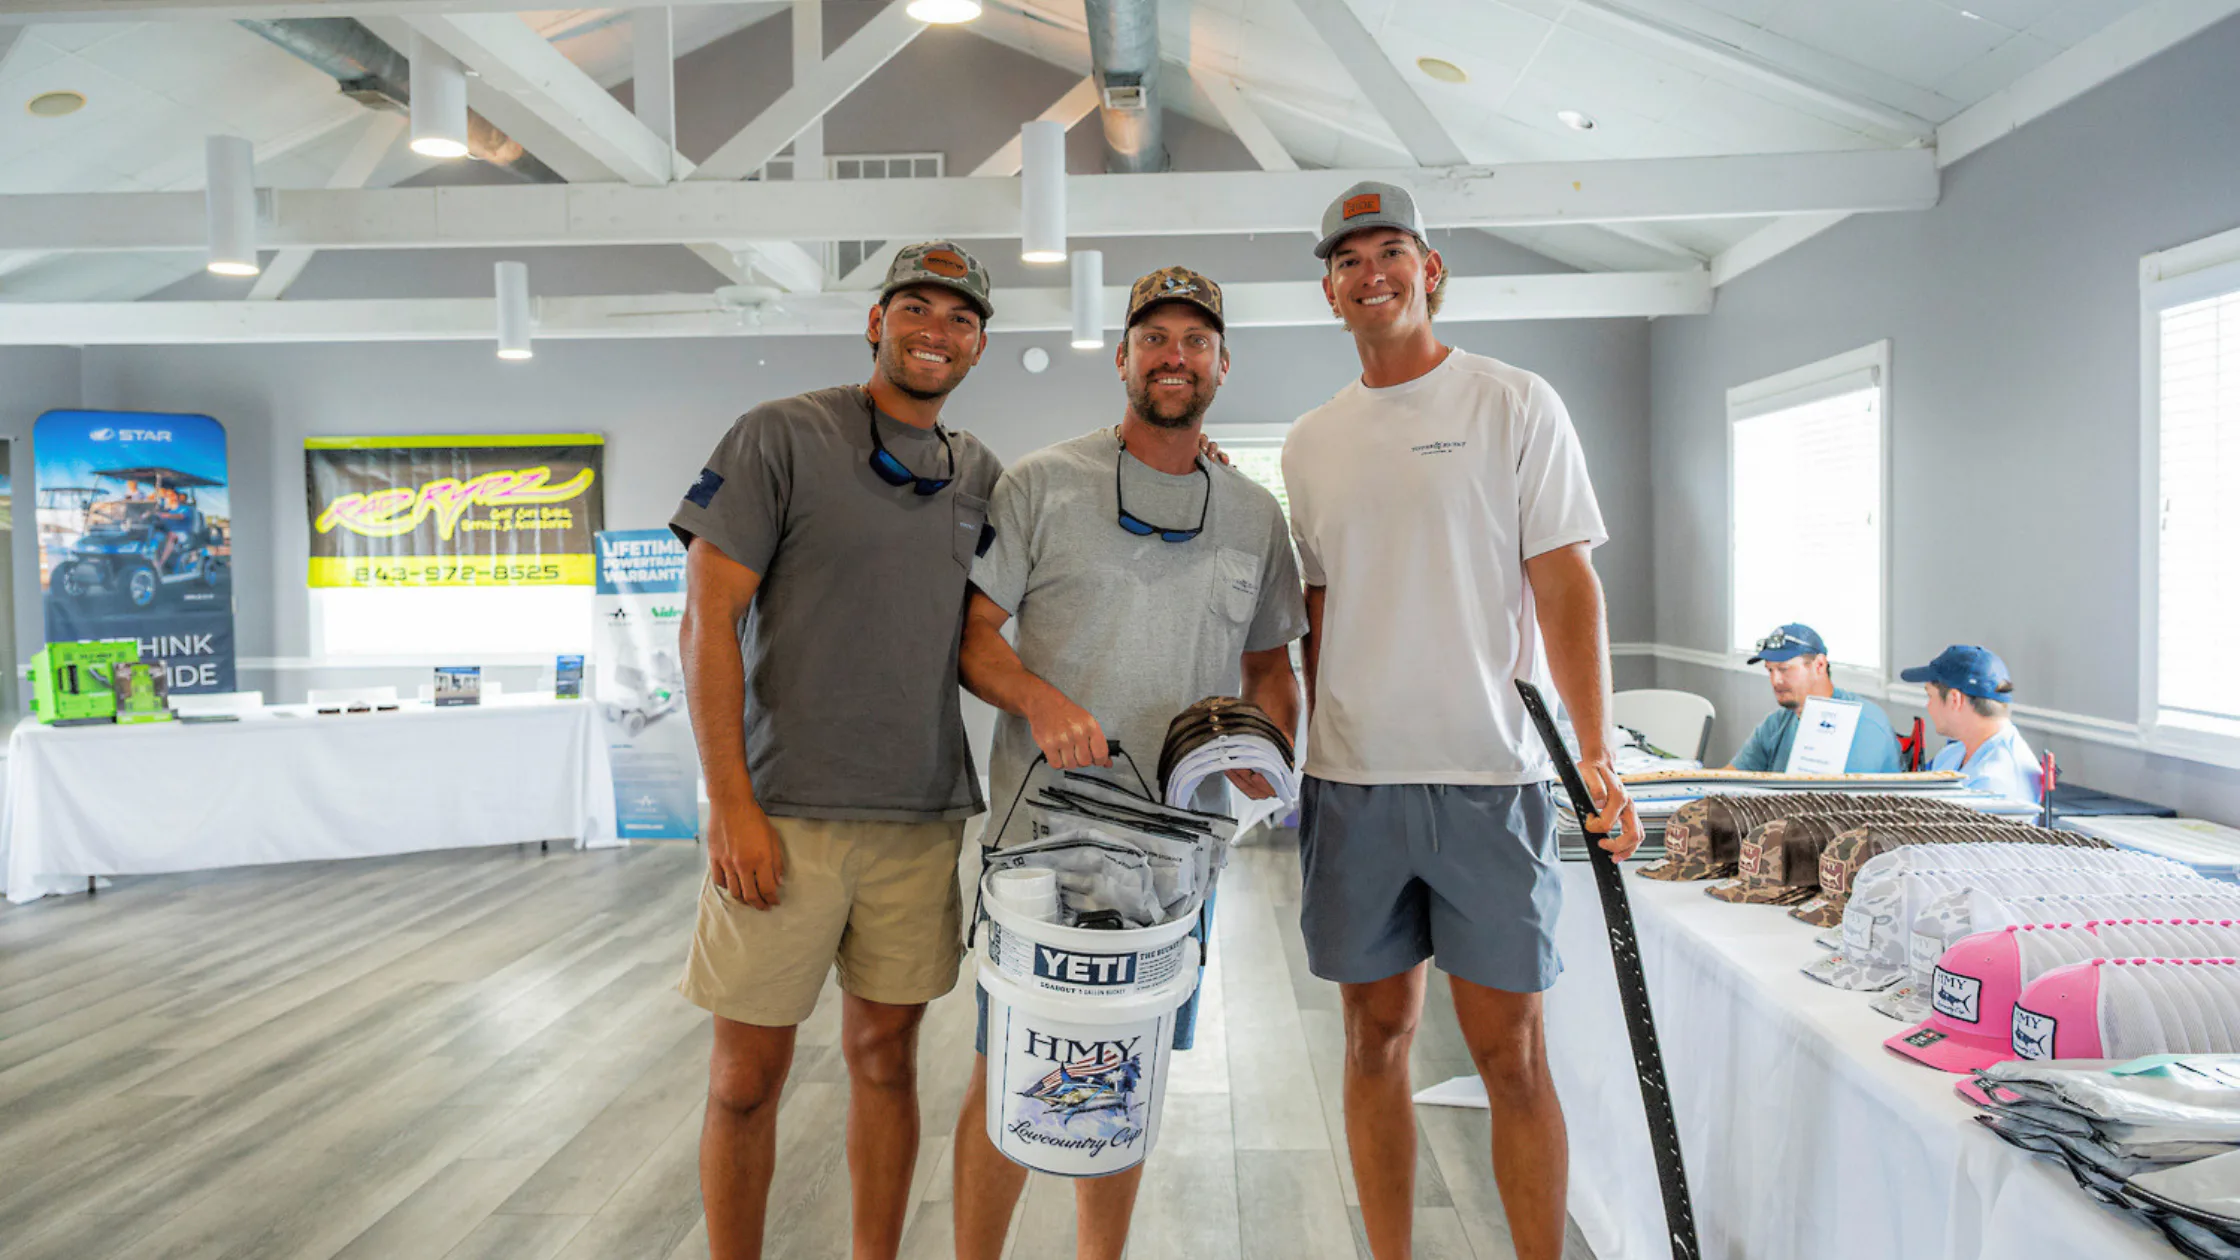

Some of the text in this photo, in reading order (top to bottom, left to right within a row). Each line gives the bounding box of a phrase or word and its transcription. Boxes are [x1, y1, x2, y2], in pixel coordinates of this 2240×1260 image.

[119, 429, 172, 442] STAR
[316, 488, 417, 537] RAD
[603, 539, 687, 557] LIFETIME
[603, 555, 687, 569] POWERTRAIN
[355, 563, 560, 582] 843-972-8525
[603, 568, 687, 584] WARRANTY
[162, 663, 218, 688] IDE
[1040, 948, 1132, 982] YETI
[1140, 951, 1155, 960] THE
[1937, 971, 1967, 990] HMY
[1084, 988, 1104, 996] GALLON
[1106, 988, 1126, 996] BUCKET
[1024, 1028, 1142, 1065] HMY
[1008, 1119, 1143, 1158] Lowcountry Cup
